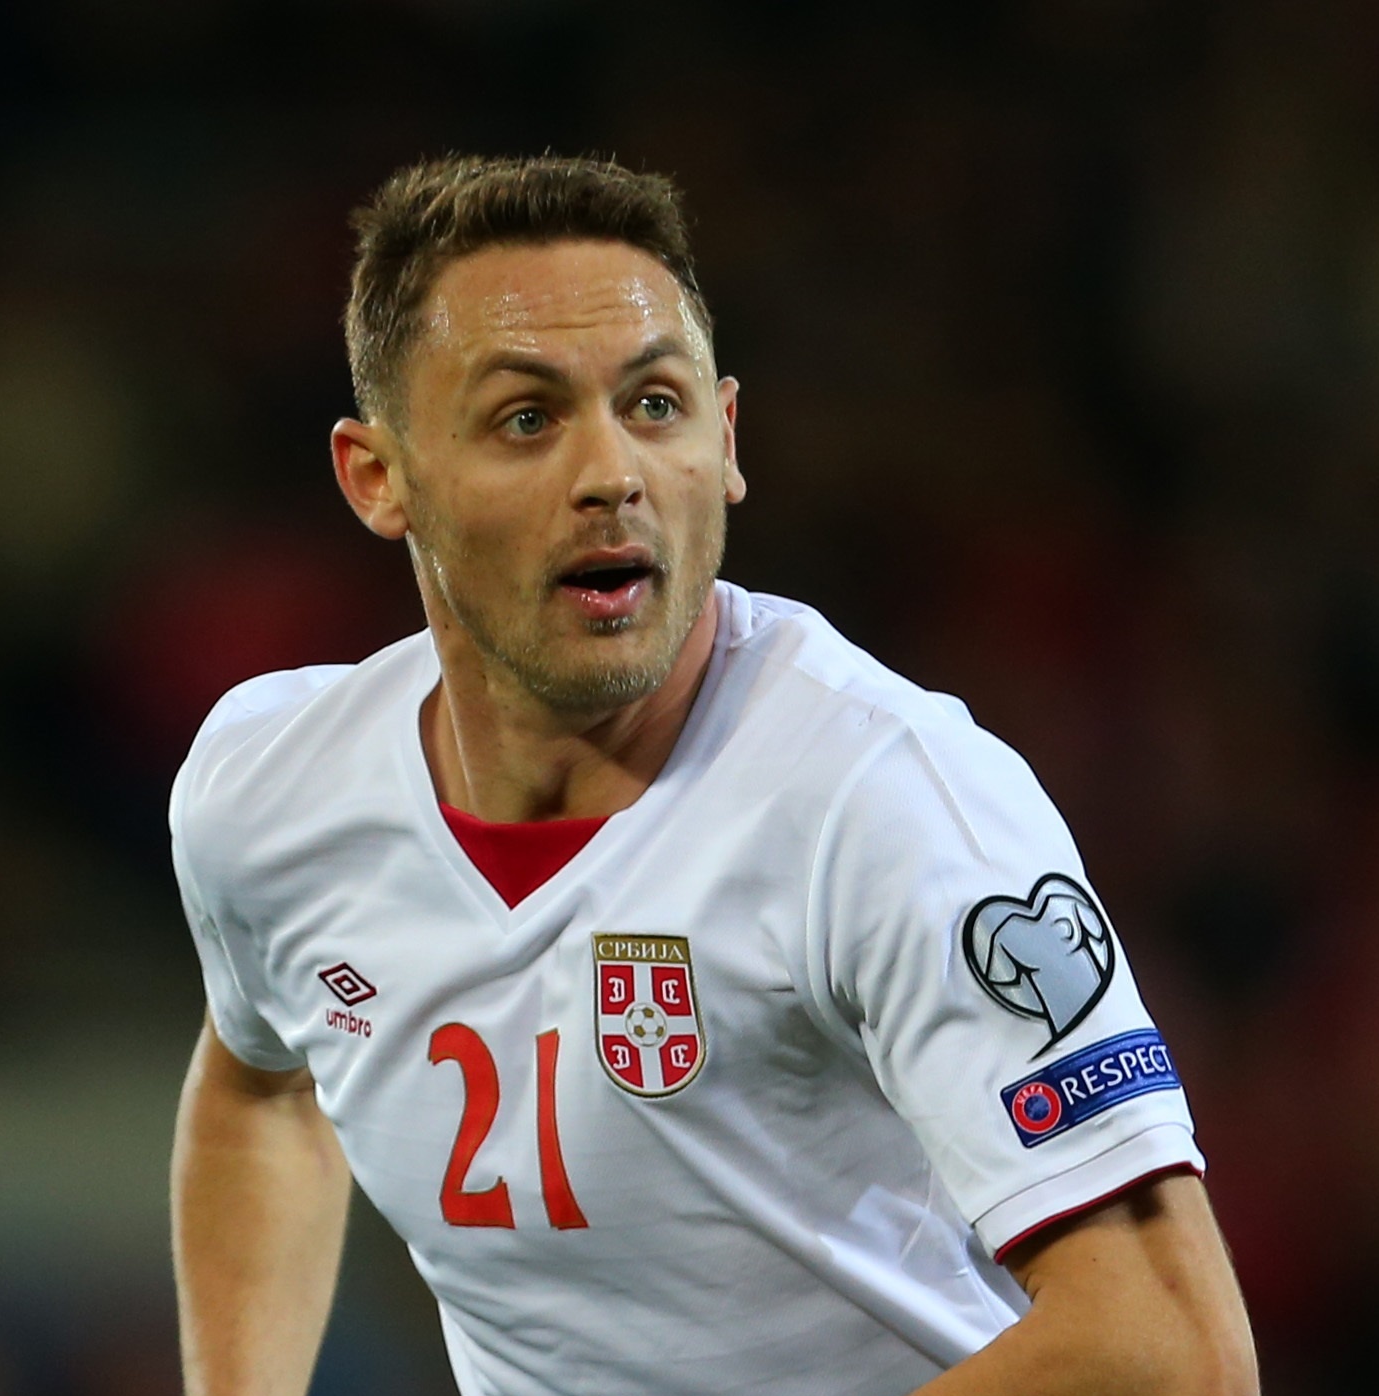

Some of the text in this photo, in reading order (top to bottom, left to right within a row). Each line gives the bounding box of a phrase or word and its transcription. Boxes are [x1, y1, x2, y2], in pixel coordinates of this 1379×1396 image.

[325, 1008, 373, 1039] umbro
[1016, 1084, 1044, 1104] UEFA
[1059, 1044, 1173, 1106] RESPECT
[428, 1022, 590, 1230] 21
